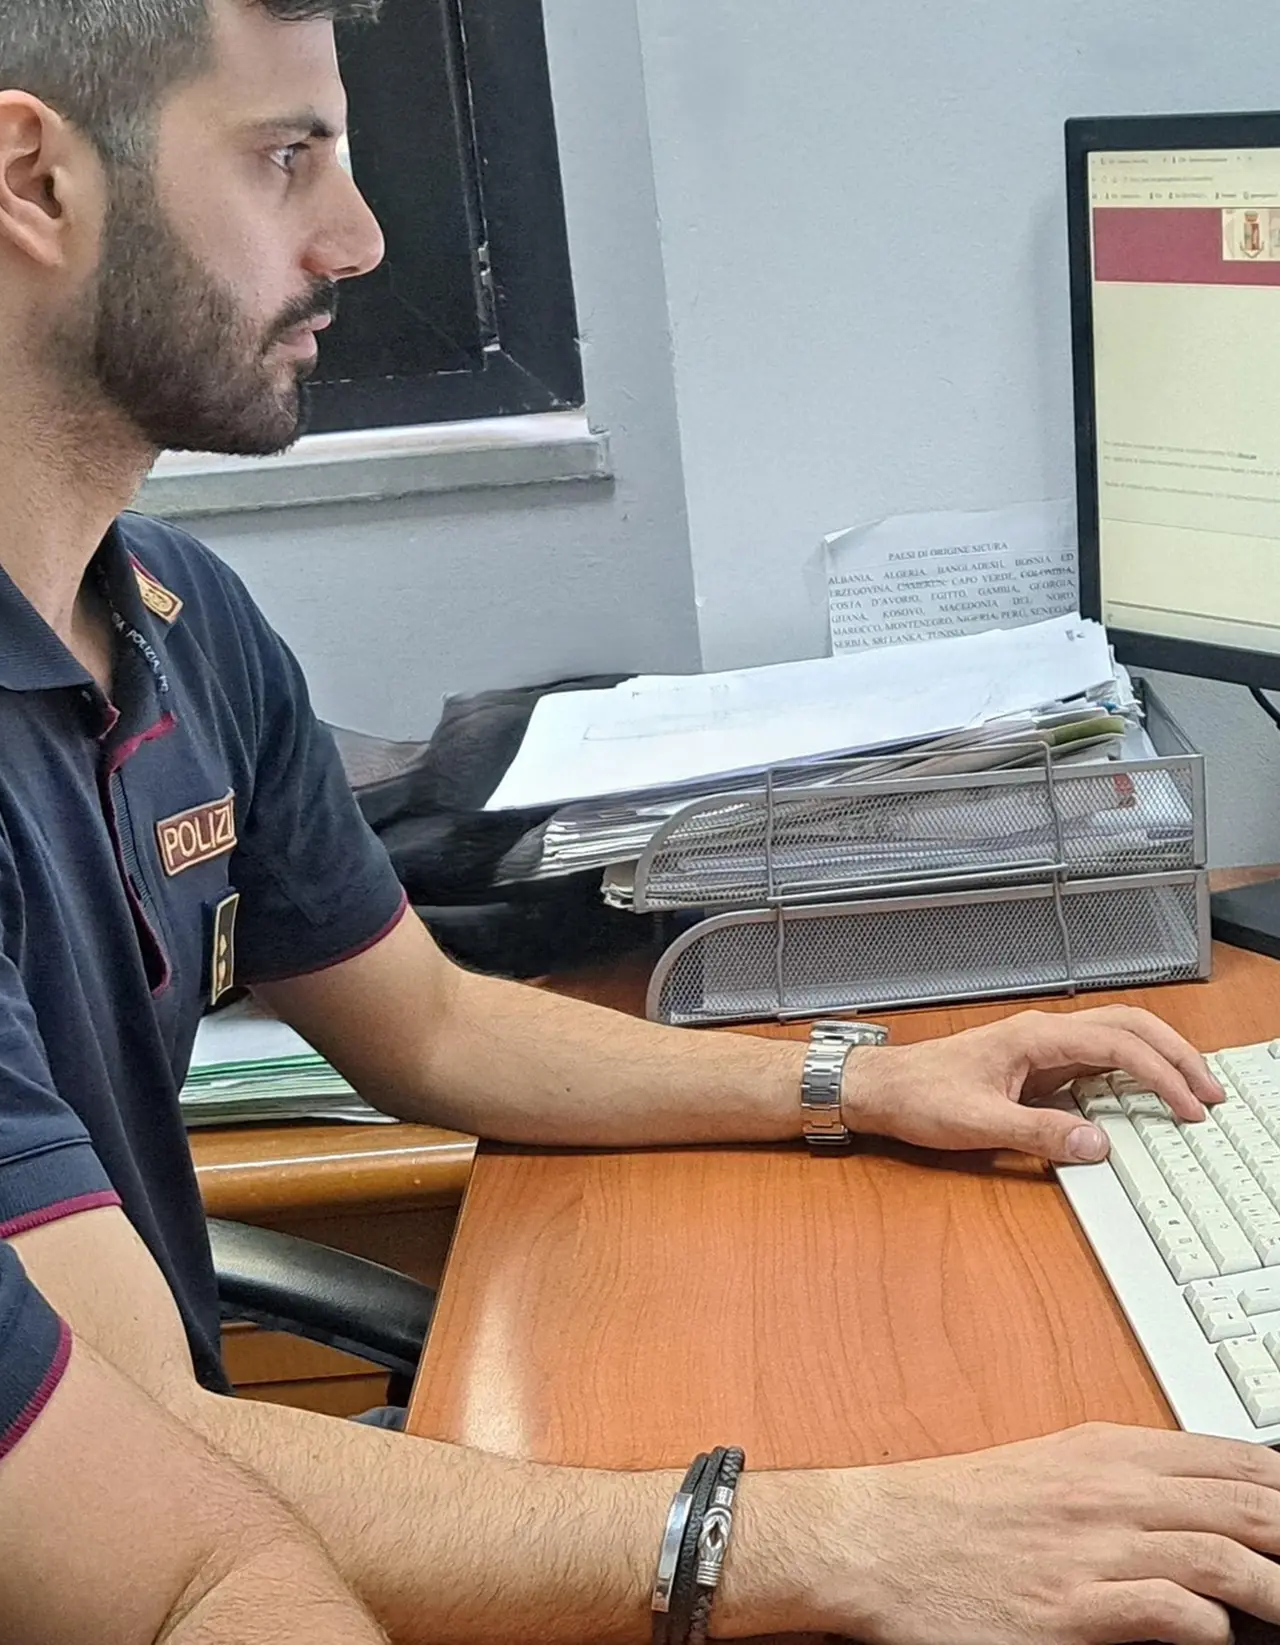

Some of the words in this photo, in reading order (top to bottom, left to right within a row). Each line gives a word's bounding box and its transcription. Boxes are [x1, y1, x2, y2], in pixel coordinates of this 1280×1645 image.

[1061, 553, 1074, 562] ED
[830, 600, 862, 611] COSTA
[164, 804, 233, 866] POLIZI
